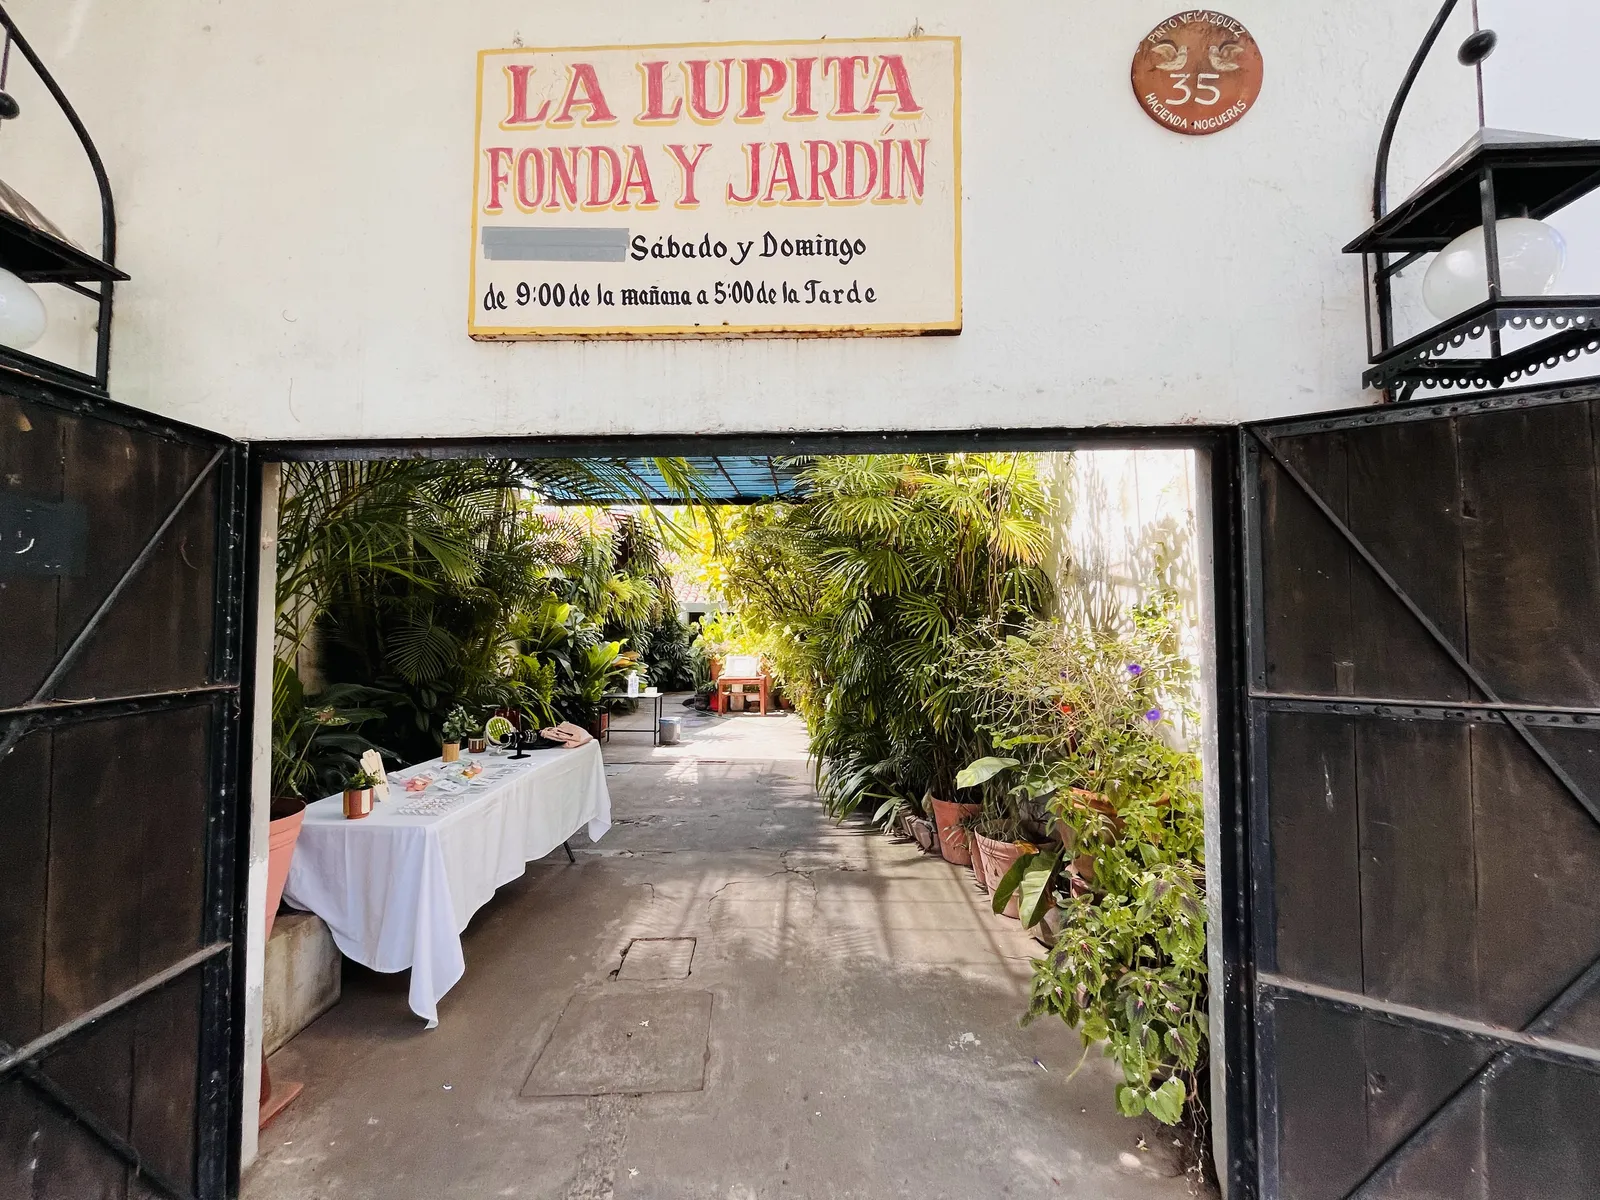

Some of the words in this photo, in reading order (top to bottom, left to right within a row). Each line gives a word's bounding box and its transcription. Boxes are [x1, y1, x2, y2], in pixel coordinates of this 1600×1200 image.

[1148, 18, 1178, 43] PINTO
[501, 62, 617, 129] LA
[636, 54, 924, 126] LUPITA
[1165, 73, 1220, 105] 35
[1145, 92, 1187, 128] HACIENDA
[1193, 99, 1247, 130] NOGUERAS
[483, 145, 659, 212] FONDA
[664, 143, 712, 209] Y
[727, 123, 929, 206] JARDÍN
[630, 233, 727, 261] Sábado
[729, 240, 754, 265] y
[758, 230, 867, 265] Domingo
[483, 282, 508, 311] de
[515, 281, 566, 307] 9:00
[569, 283, 590, 307] de
[597, 282, 615, 306] la
[620, 285, 693, 306] mañana
[696, 290, 710, 305] a
[714, 280, 754, 304] 5:00
[756, 280, 777, 304] de
[782, 280, 801, 304] la
[804, 279, 877, 304] Tarde
